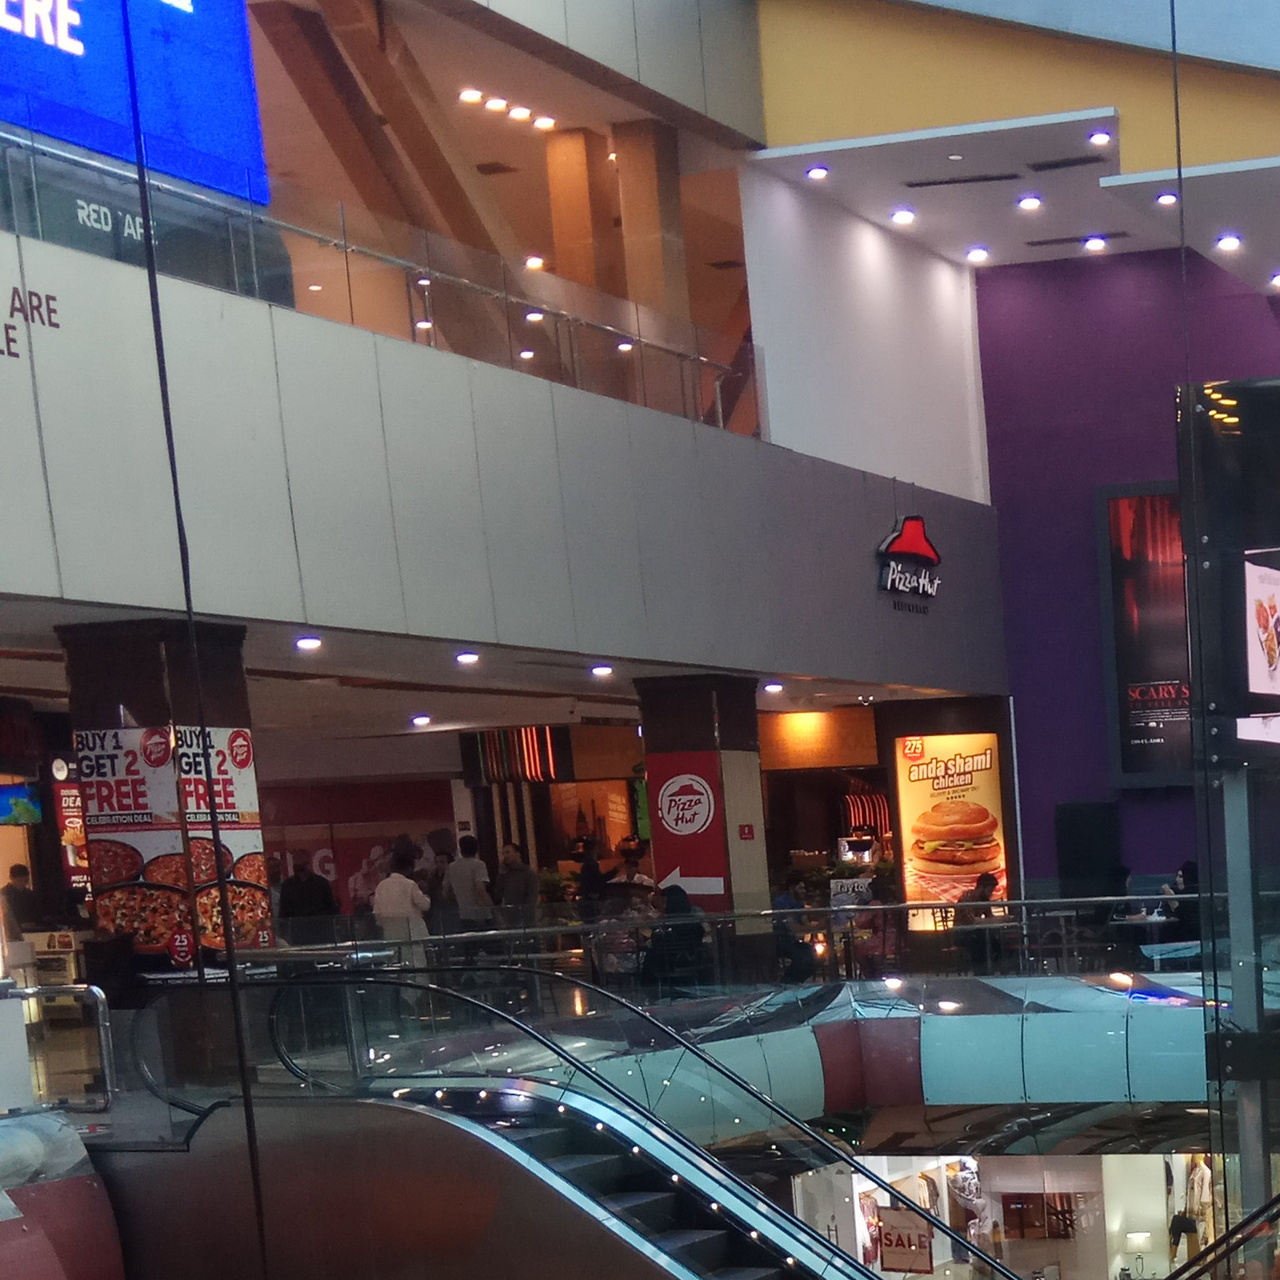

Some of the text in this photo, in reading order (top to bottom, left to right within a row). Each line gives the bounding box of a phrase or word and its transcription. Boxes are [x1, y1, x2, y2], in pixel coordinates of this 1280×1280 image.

[76, 199, 113, 233] RED
[9, 286, 61, 329] ARE
[887, 560, 942, 596] Pizza Hut
[1128, 684, 1190, 700] SCARY S
[77, 731, 123, 751] BUY 1
[177, 730, 202, 749] BUY
[904, 740, 923, 754] 275
[79, 749, 141, 778] GET 2
[215, 749, 229, 776] 2
[909, 748, 992, 782] anda shami
[933, 773, 972, 790] chicken
[62, 797, 82, 807] DEA
[82, 777, 149, 813] FREE
[667, 797, 703, 815] Pizza
[133, 812, 152, 823] DEAL
[673, 811, 699, 827] Hut
[174, 934, 188, 946] 25
[258, 930, 269, 942] 25
[883, 1232, 928, 1249] SALE
